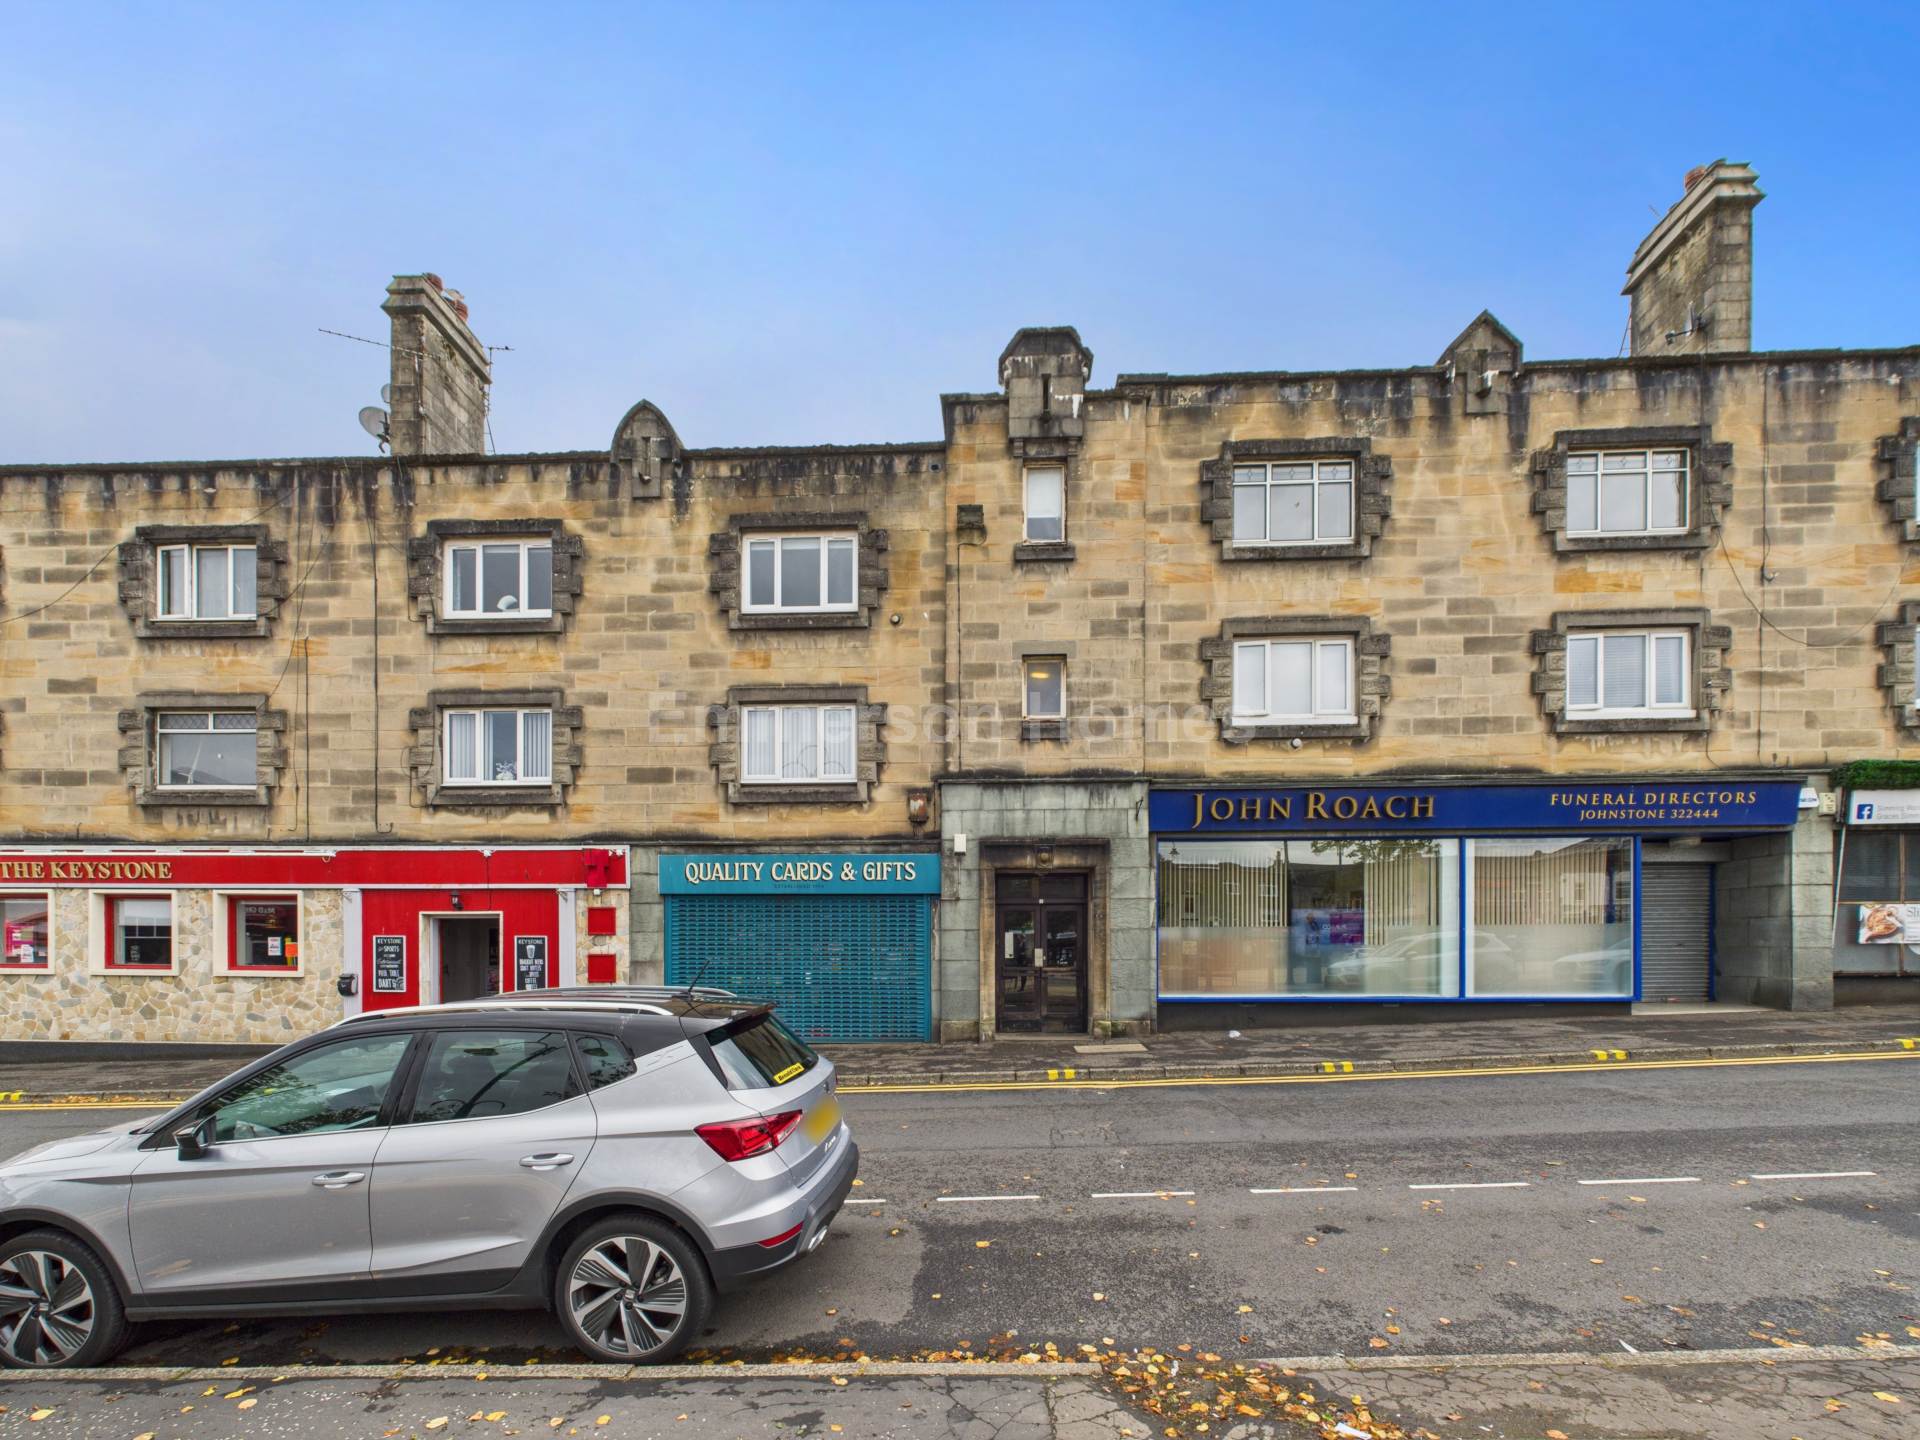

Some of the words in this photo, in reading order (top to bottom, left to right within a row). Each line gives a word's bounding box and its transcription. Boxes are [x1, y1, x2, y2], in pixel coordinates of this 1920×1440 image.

[1550, 792, 1637, 805] FUNERAL
[1645, 791, 1757, 804] DIRECTORS
[1191, 792, 1292, 828] JOHN
[1305, 792, 1436, 819] ROACH
[1580, 809, 1665, 821] JOHNSTONE
[1671, 808, 1719, 819] 322444
[0, 861, 45, 879] THE
[49, 861, 173, 880] KEYSTONE
[685, 862, 764, 884] QUALITY
[771, 862, 834, 881] CARDS
[840, 862, 857, 881] &
[863, 861, 917, 881] GIFTS
[378, 978, 396, 988] DARTS
